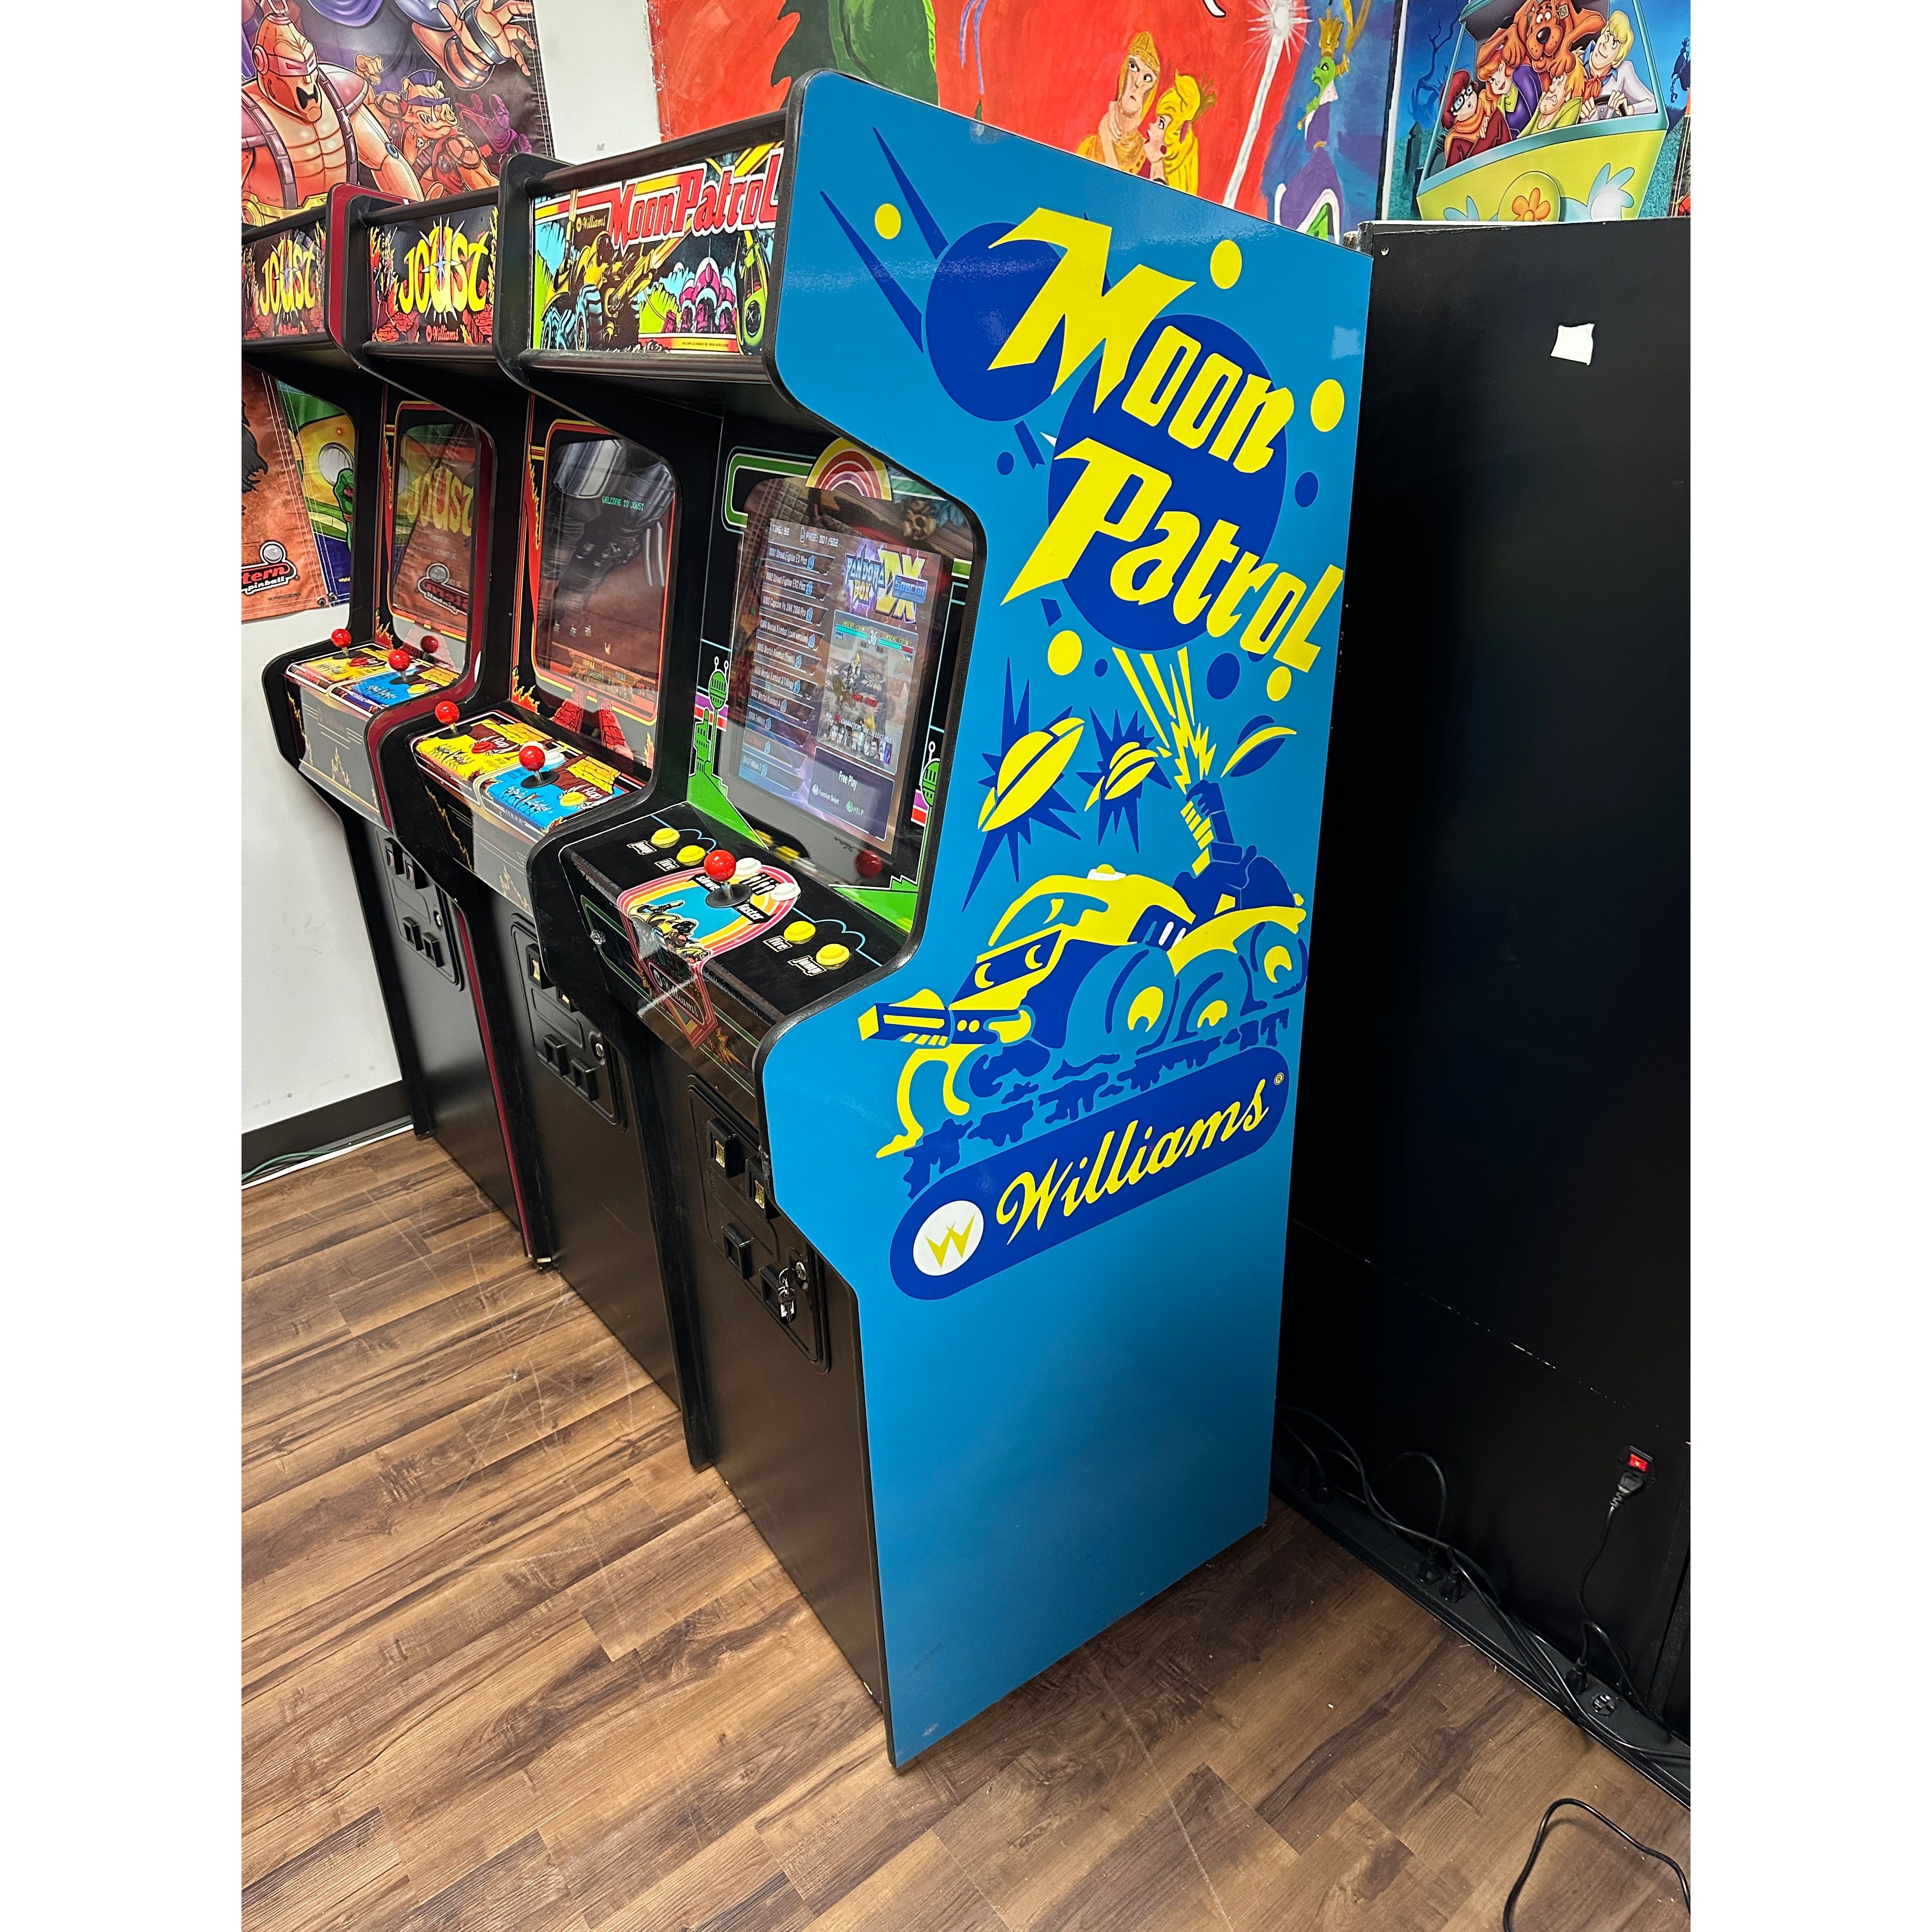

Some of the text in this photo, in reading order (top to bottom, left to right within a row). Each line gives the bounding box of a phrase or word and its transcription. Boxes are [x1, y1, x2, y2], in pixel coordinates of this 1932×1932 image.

[576, 152, 780, 249] Moon Patrol
[582, 214, 606, 230] Williams
[398, 226, 489, 314] JOUST
[433, 325, 459, 341] Williams
[988, 207, 1343, 672] Moon Patrol
[602, 496, 621, 506] WELCOME
[623, 500, 629, 508] TO
[805, 532, 818, 542] PAGE:
[248, 575, 286, 591] pinball
[894, 577, 926, 597] Special
[868, 630, 878, 645] 36
[839, 771, 858, 791] Free Play
[853, 806, 863, 815] HELP
[696, 875, 721, 891] slowe
[792, 957, 822, 974] jump
[997, 1079, 1269, 1245] Williams
